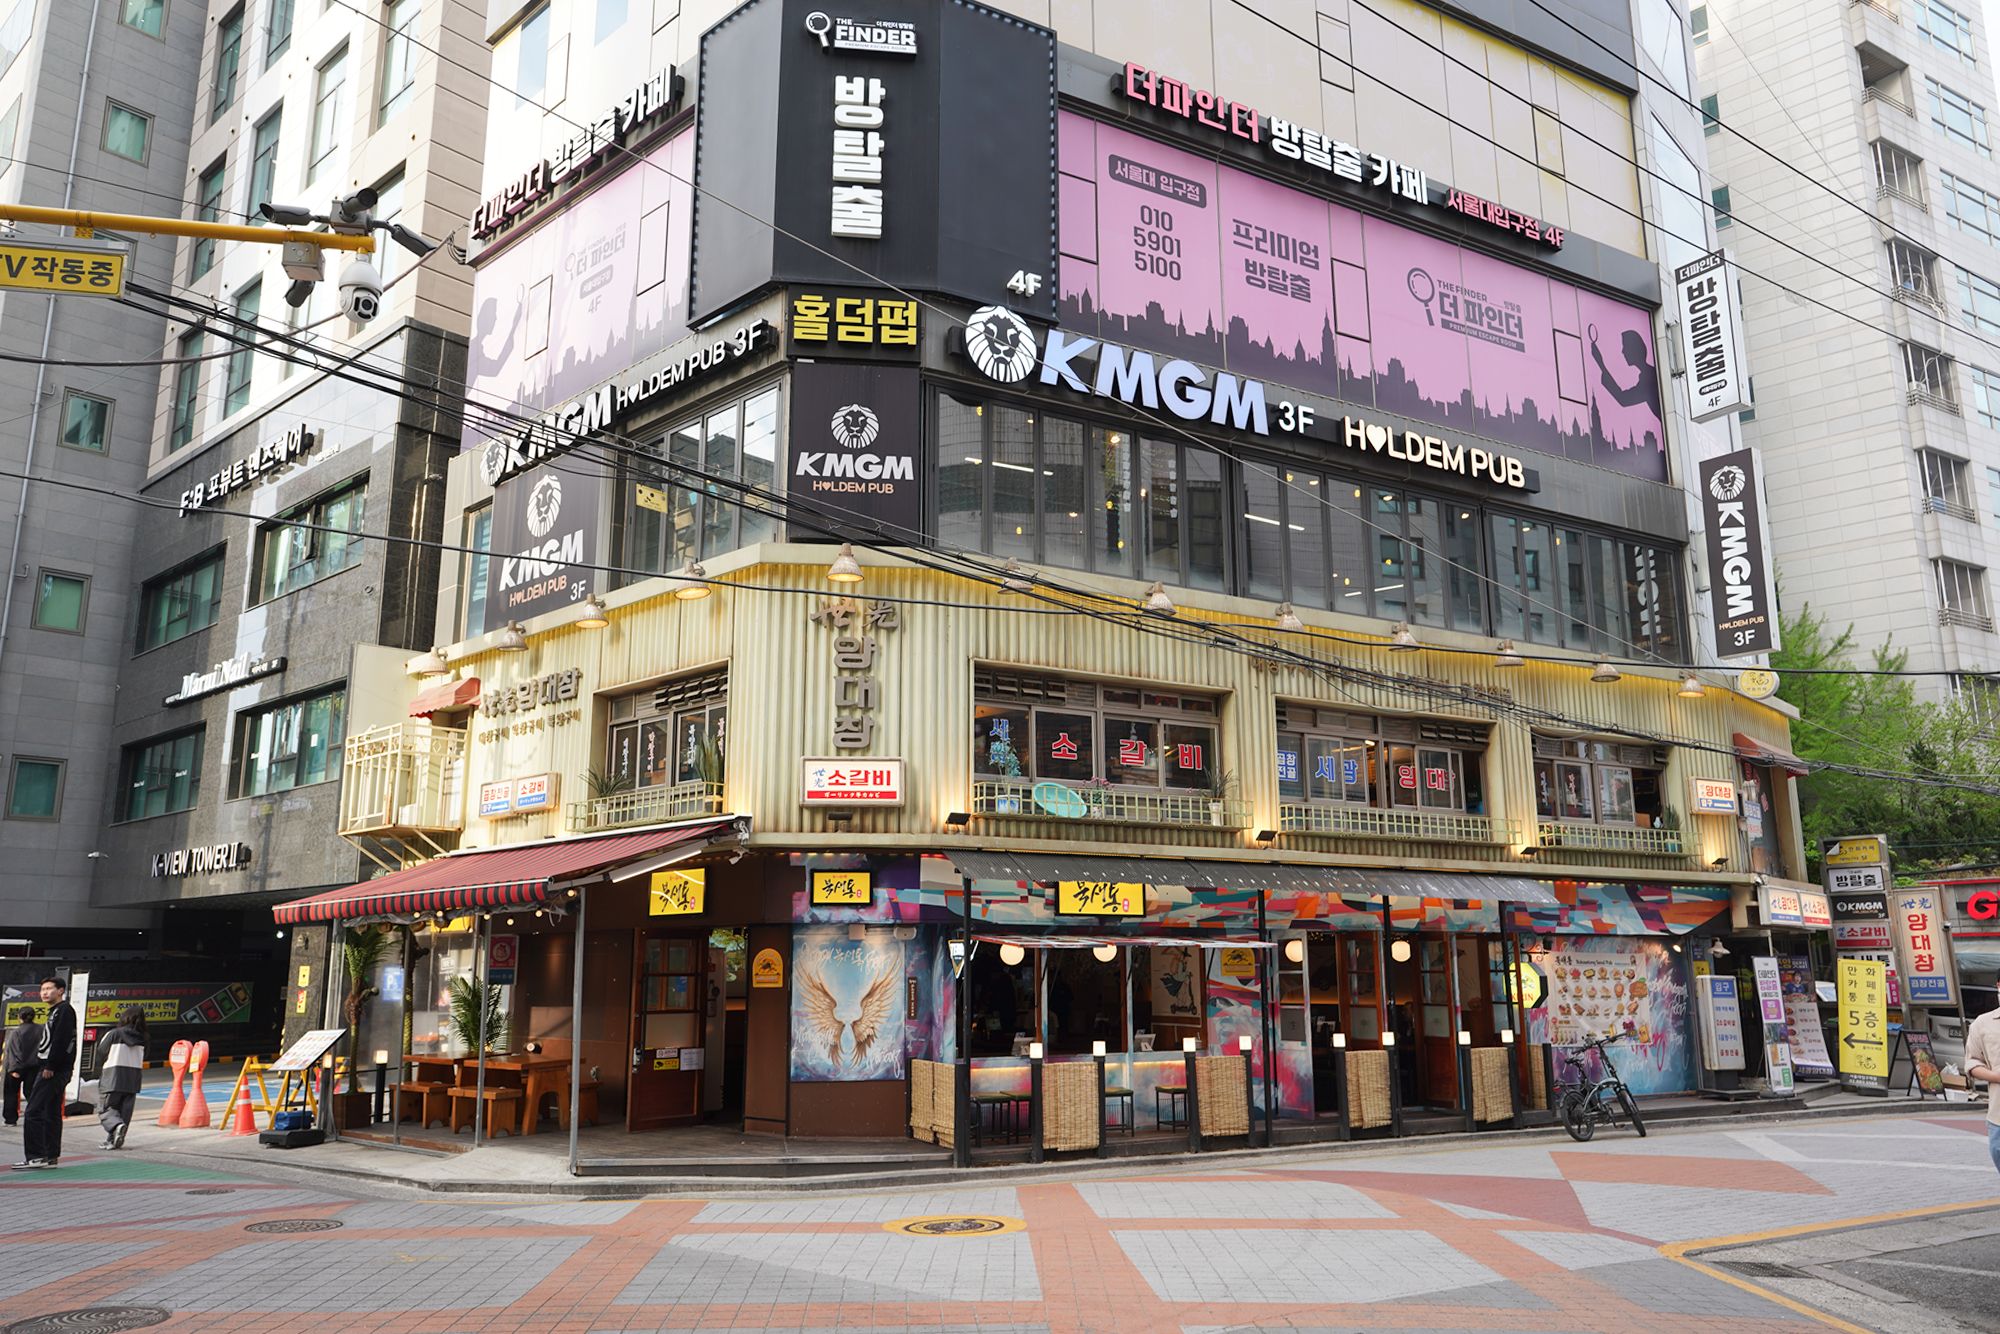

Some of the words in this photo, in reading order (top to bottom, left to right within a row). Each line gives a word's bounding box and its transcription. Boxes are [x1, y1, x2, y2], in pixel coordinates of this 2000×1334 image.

[836, 18, 852, 26] THE
[471, 160, 548, 238] 더파인더
[621, 64, 673, 133] 카페
[831, 75, 886, 239] 방탈출
[1125, 62, 1260, 144] 더파인더
[1270, 116, 1362, 183] 방탈출
[1369, 153, 1429, 205] 카페
[1448, 187, 1540, 241] 서울대입구점
[1545, 226, 1565, 247] 4F
[1115, 159, 1156, 188] 서울대
[1160, 175, 1200, 202] 입구점
[1140, 204, 1173, 232] 010
[1133, 226, 1181, 258] 5901
[1232, 218, 1319, 271] 프리미엄
[31, 257, 115, 288] 작동중
[1134, 250, 1182, 281] 5100
[1679, 254, 1721, 280] 더파인더
[1007, 269, 1042, 297] 4F
[1245, 258, 1311, 303] 방탈출
[1437, 279, 1454, 292] THE
[1455, 285, 1488, 302] FINDER
[793, 294, 918, 346] 홀덤펍
[1439, 291, 1459, 320] 더
[1464, 299, 1524, 340] 파인더
[1686, 276, 1727, 383] 방탈출
[687, 340, 726, 377] PUB
[733, 318, 763, 357] 3F
[1040, 328, 1269, 436] KMGM
[1278, 400, 1315, 434] 3F
[1469, 447, 1526, 489] PUB
[1708, 395, 1722, 407] 4F
[796, 452, 914, 480] KMGM
[868, 482, 894, 494] PUB
[499, 529, 584, 592] KMGM
[1717, 501, 1754, 619] KMGM
[548, 575, 567, 595] PUB
[570, 580, 587, 601] 3F
[1749, 615, 1765, 625] PUB
[1734, 629, 1756, 647] 3F
[833, 636, 876, 749] 양대창
[521, 780, 545, 795] 소갈비
[828, 769, 891, 786] 소갈비
[151, 849, 189, 877] K-VIEW
[191, 843, 229, 873] TOWER
[1835, 874, 1877, 888] 방탈출
[1847, 901, 1883, 911] KMGM
[1901, 897, 1932, 909] 世光
[1967, 890, 2000, 921] G
[1847, 927, 1887, 937] 소갈비
[1907, 913, 1935, 973] 양대창
[1715, 982, 1730, 992] 입구
[1849, 1010, 1879, 1029] 5층
